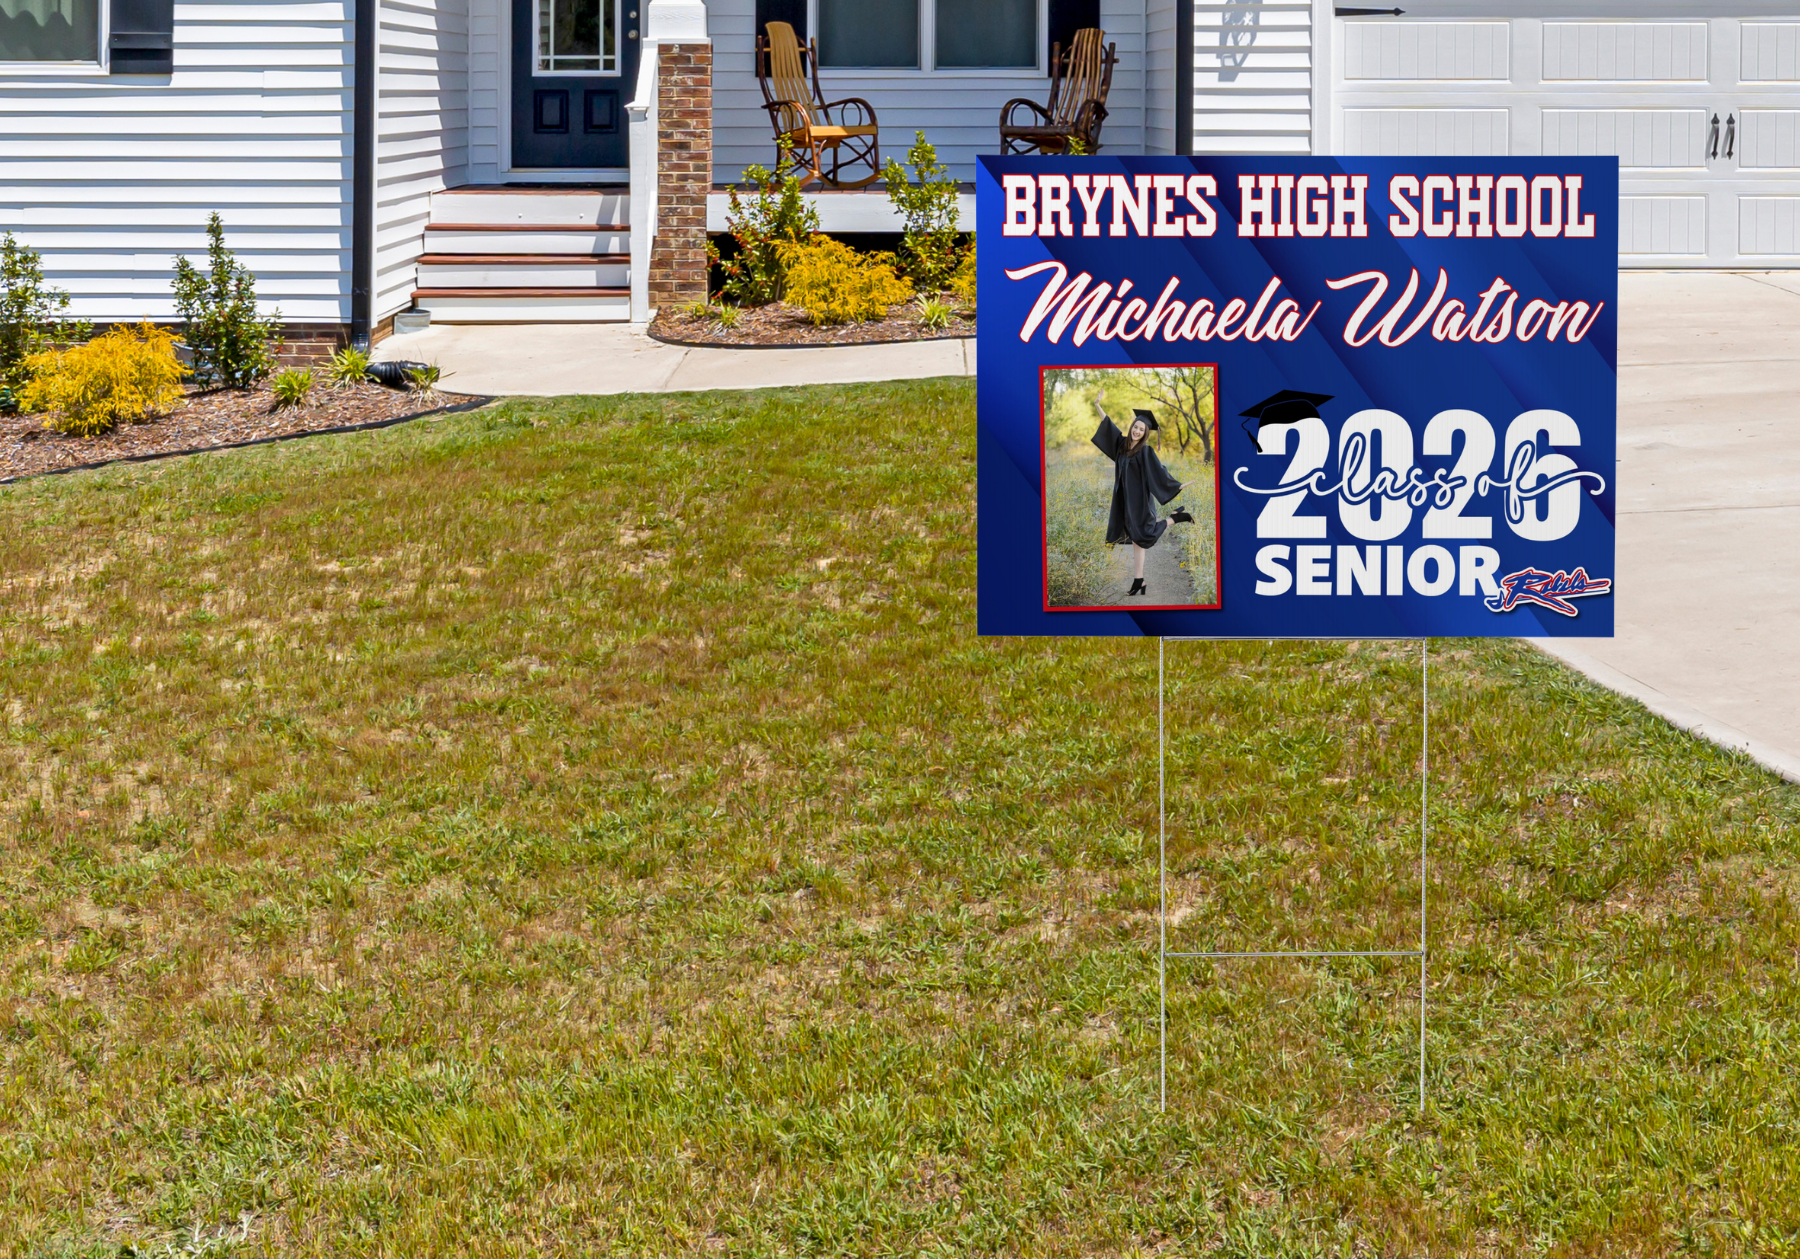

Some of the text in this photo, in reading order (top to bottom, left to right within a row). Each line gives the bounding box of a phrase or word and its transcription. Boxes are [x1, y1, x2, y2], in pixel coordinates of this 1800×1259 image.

[1002, 174, 1595, 238] BRYNES HIGH SCHOOL
[1004, 259, 1604, 347] Michaela Watson
[1233, 431, 1606, 522] class of
[1256, 408, 1582, 542] 2026
[1254, 544, 1501, 597] SENIOR
